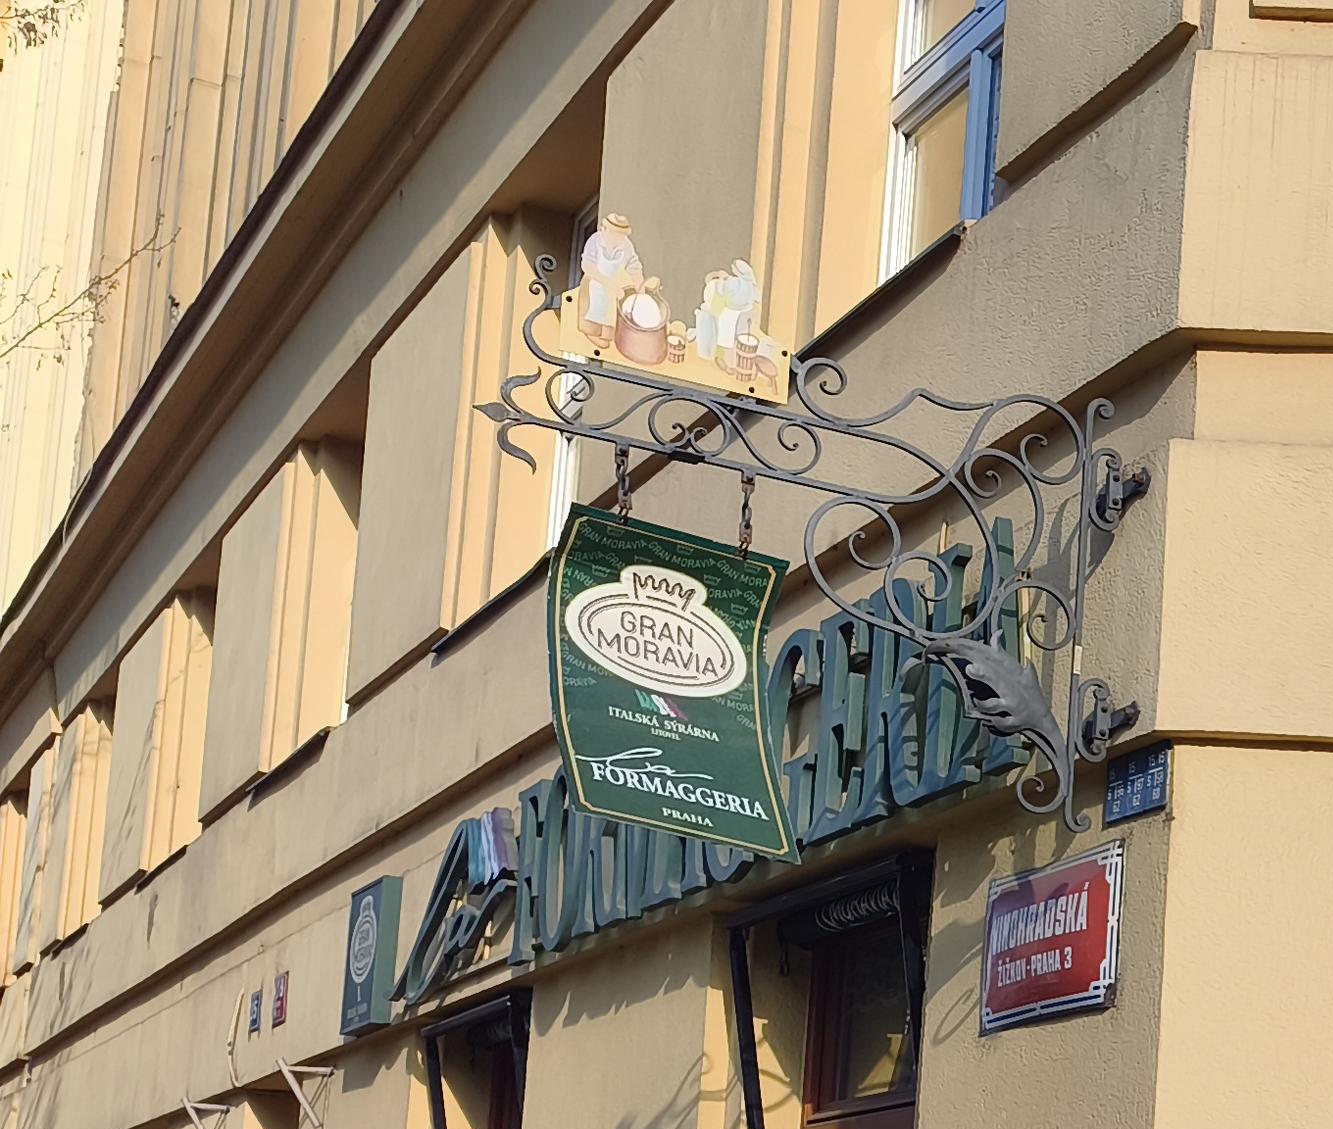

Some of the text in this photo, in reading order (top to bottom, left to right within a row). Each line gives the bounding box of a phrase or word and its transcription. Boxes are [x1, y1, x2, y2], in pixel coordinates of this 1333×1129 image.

[621, 610, 693, 649] GRAN
[597, 627, 719, 677] MORAVIA
[608, 705, 720, 742] ITALSKÁ SÝRÁRNA
[651, 727, 681, 742] LITOVEL
[575, 747, 714, 780] La
[590, 761, 770, 822] FORMAGGERIA
[662, 806, 714, 828] PRAHA
[1064, 946, 1073, 969] 3
